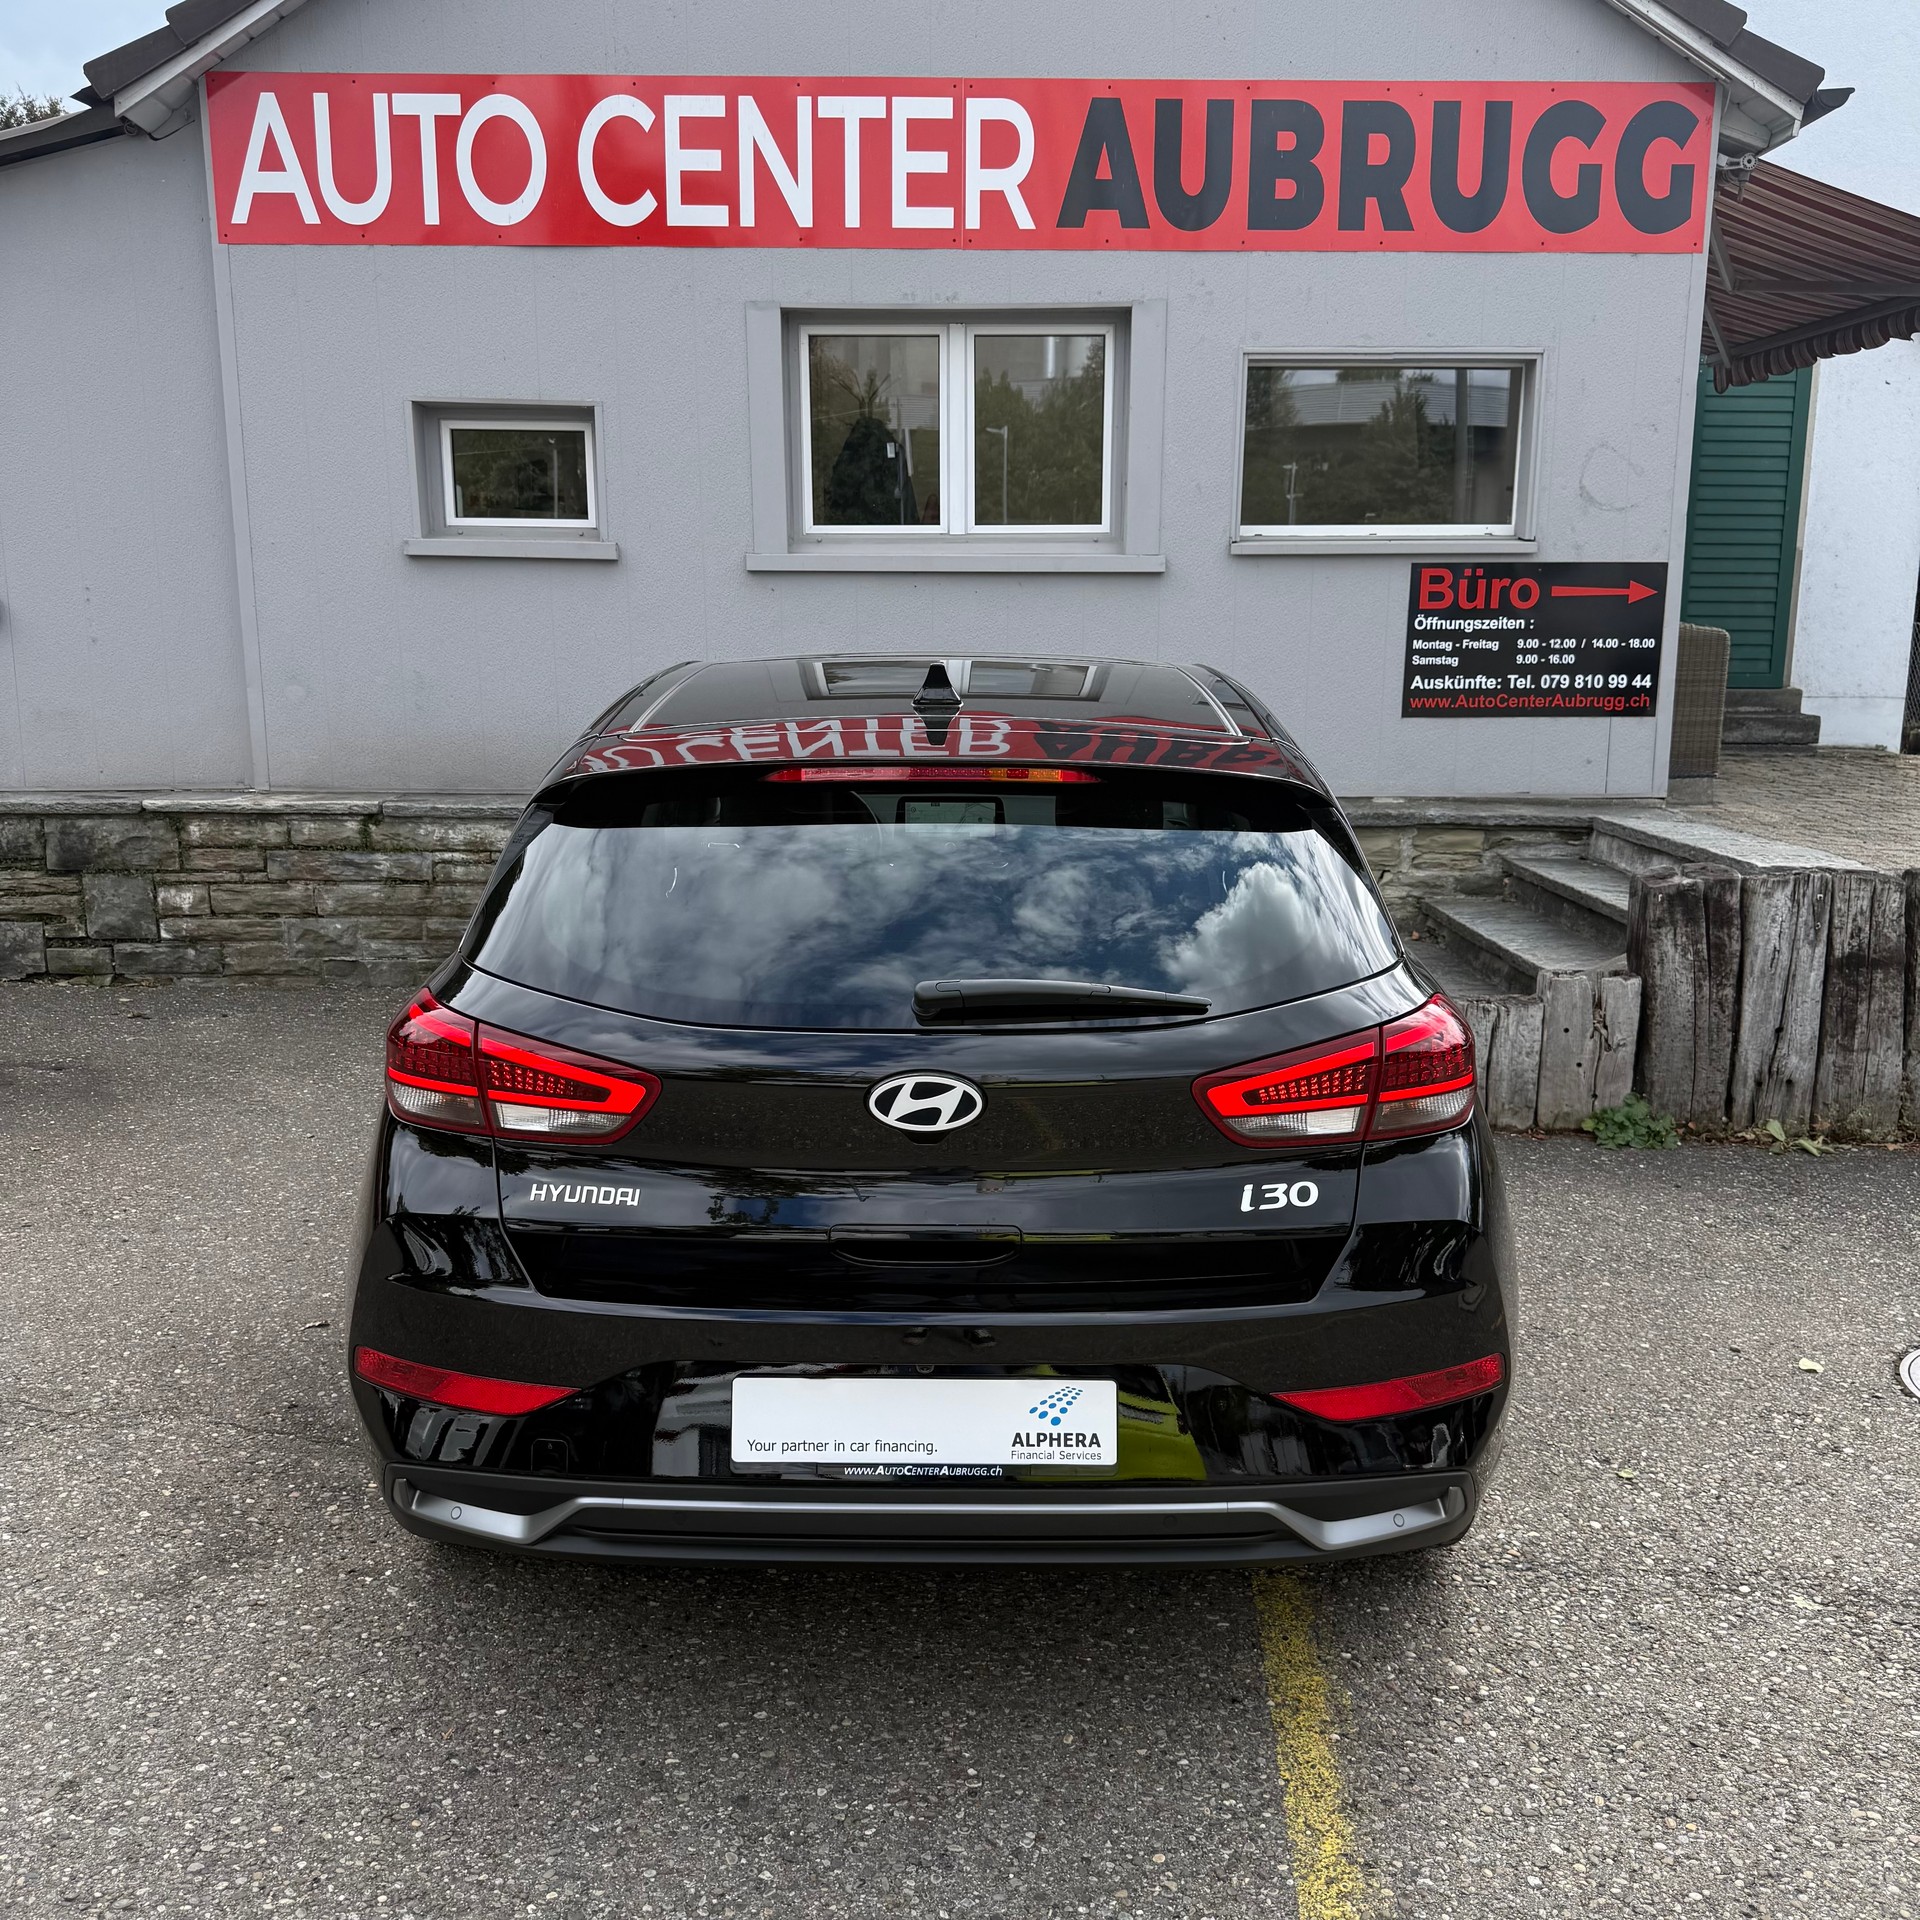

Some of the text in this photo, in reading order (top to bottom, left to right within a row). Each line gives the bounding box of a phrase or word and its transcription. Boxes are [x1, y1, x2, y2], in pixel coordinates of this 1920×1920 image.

[231, 91, 1700, 235] AUTO CENTER AUBRUGG
[1419, 568, 1540, 610] Büro
[1414, 615, 1525, 632] Öffnungszeiten
[1413, 640, 1452, 650] Montag
[1462, 639, 1499, 651] Freitag
[1517, 639, 1539, 648] 9.00
[1549, 639, 1576, 648] 12.00
[1592, 639, 1618, 648] 14.00
[1628, 639, 1655, 648] 18.00
[1412, 656, 1459, 667] Samstag
[1516, 655, 1537, 664] 9.00
[1548, 655, 1575, 664] 16.00
[1410, 674, 1651, 689] Auskünfte: Tel. 079 810 99 44
[1410, 694, 1649, 711] www.AutoCenterAubrugg.ch
[529, 1183, 640, 1206] HYUNDAI
[1241, 1181, 1319, 1212] i30
[747, 1439, 938, 1456] Your partner in car financing.
[1011, 1432, 1101, 1448] ALPHERA
[1011, 1450, 1102, 1461] Financial Services
